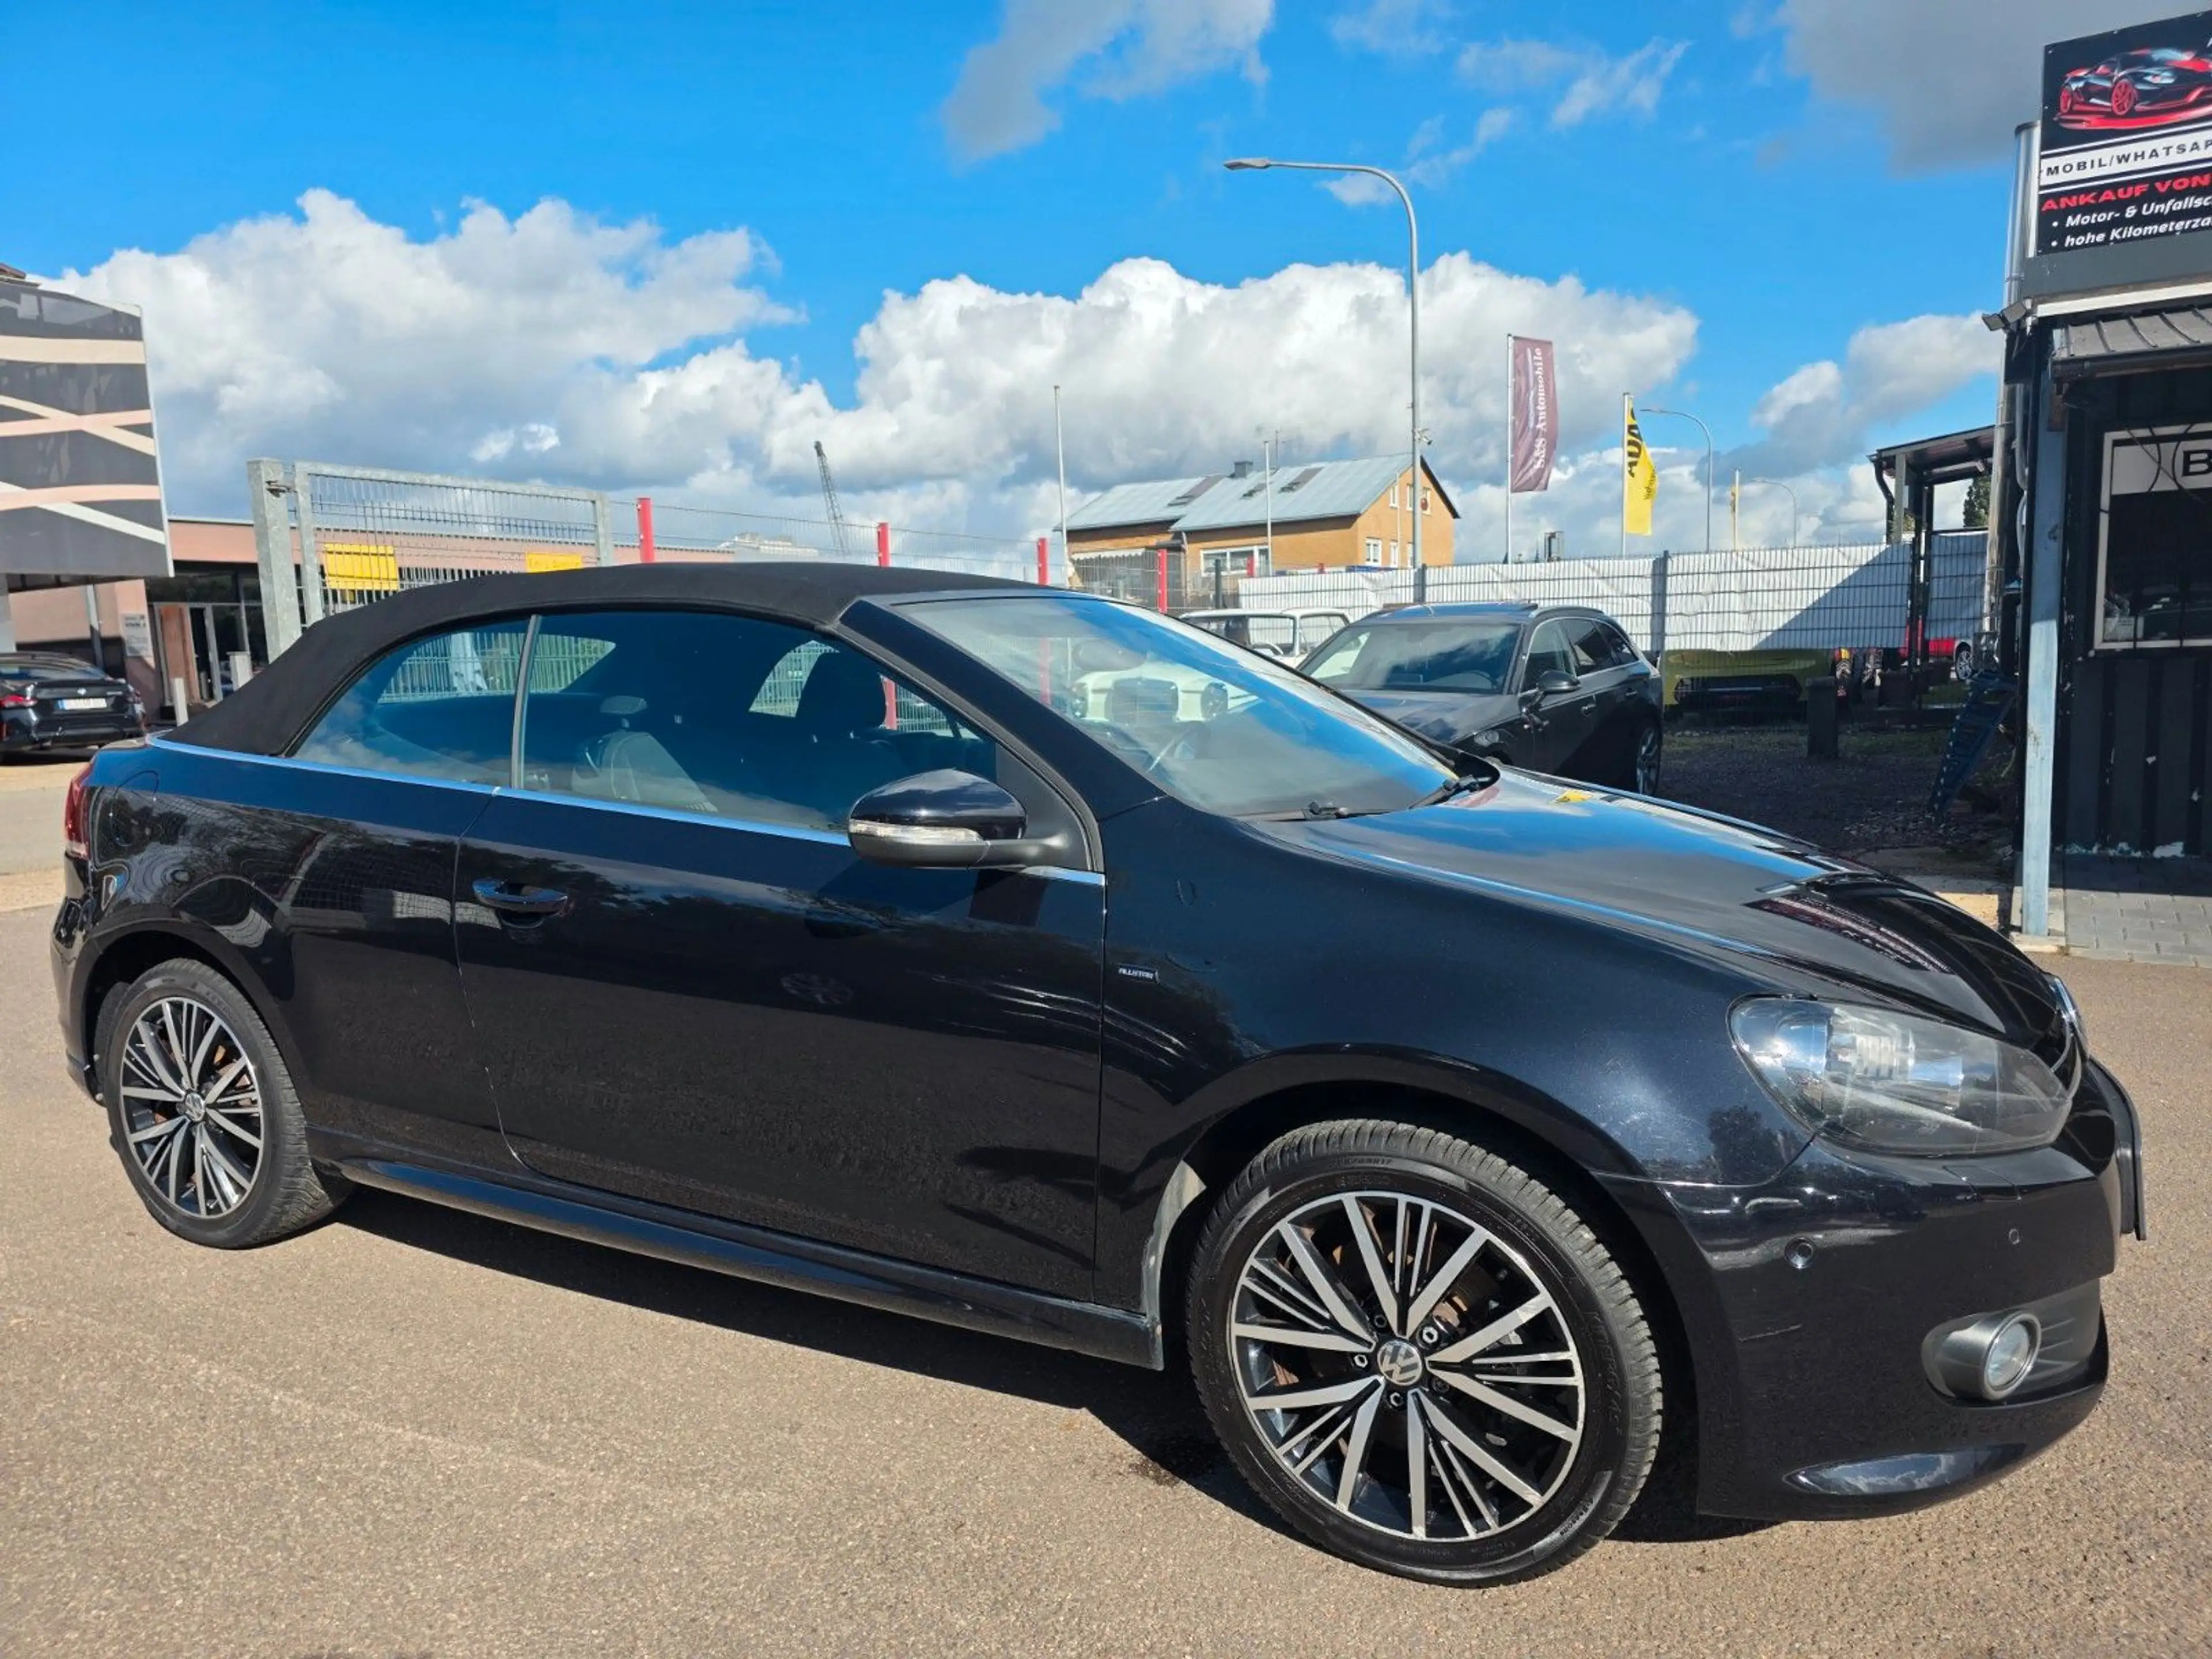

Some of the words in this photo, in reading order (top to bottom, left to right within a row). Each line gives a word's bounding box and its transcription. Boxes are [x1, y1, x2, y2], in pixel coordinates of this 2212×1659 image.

[2041, 183, 2149, 212] ANKAUF
[2155, 173, 2212, 193] VON
[2065, 211, 2120, 228] Motor-
[2124, 205, 2138, 218] &
[2065, 232, 2105, 248] hohe
